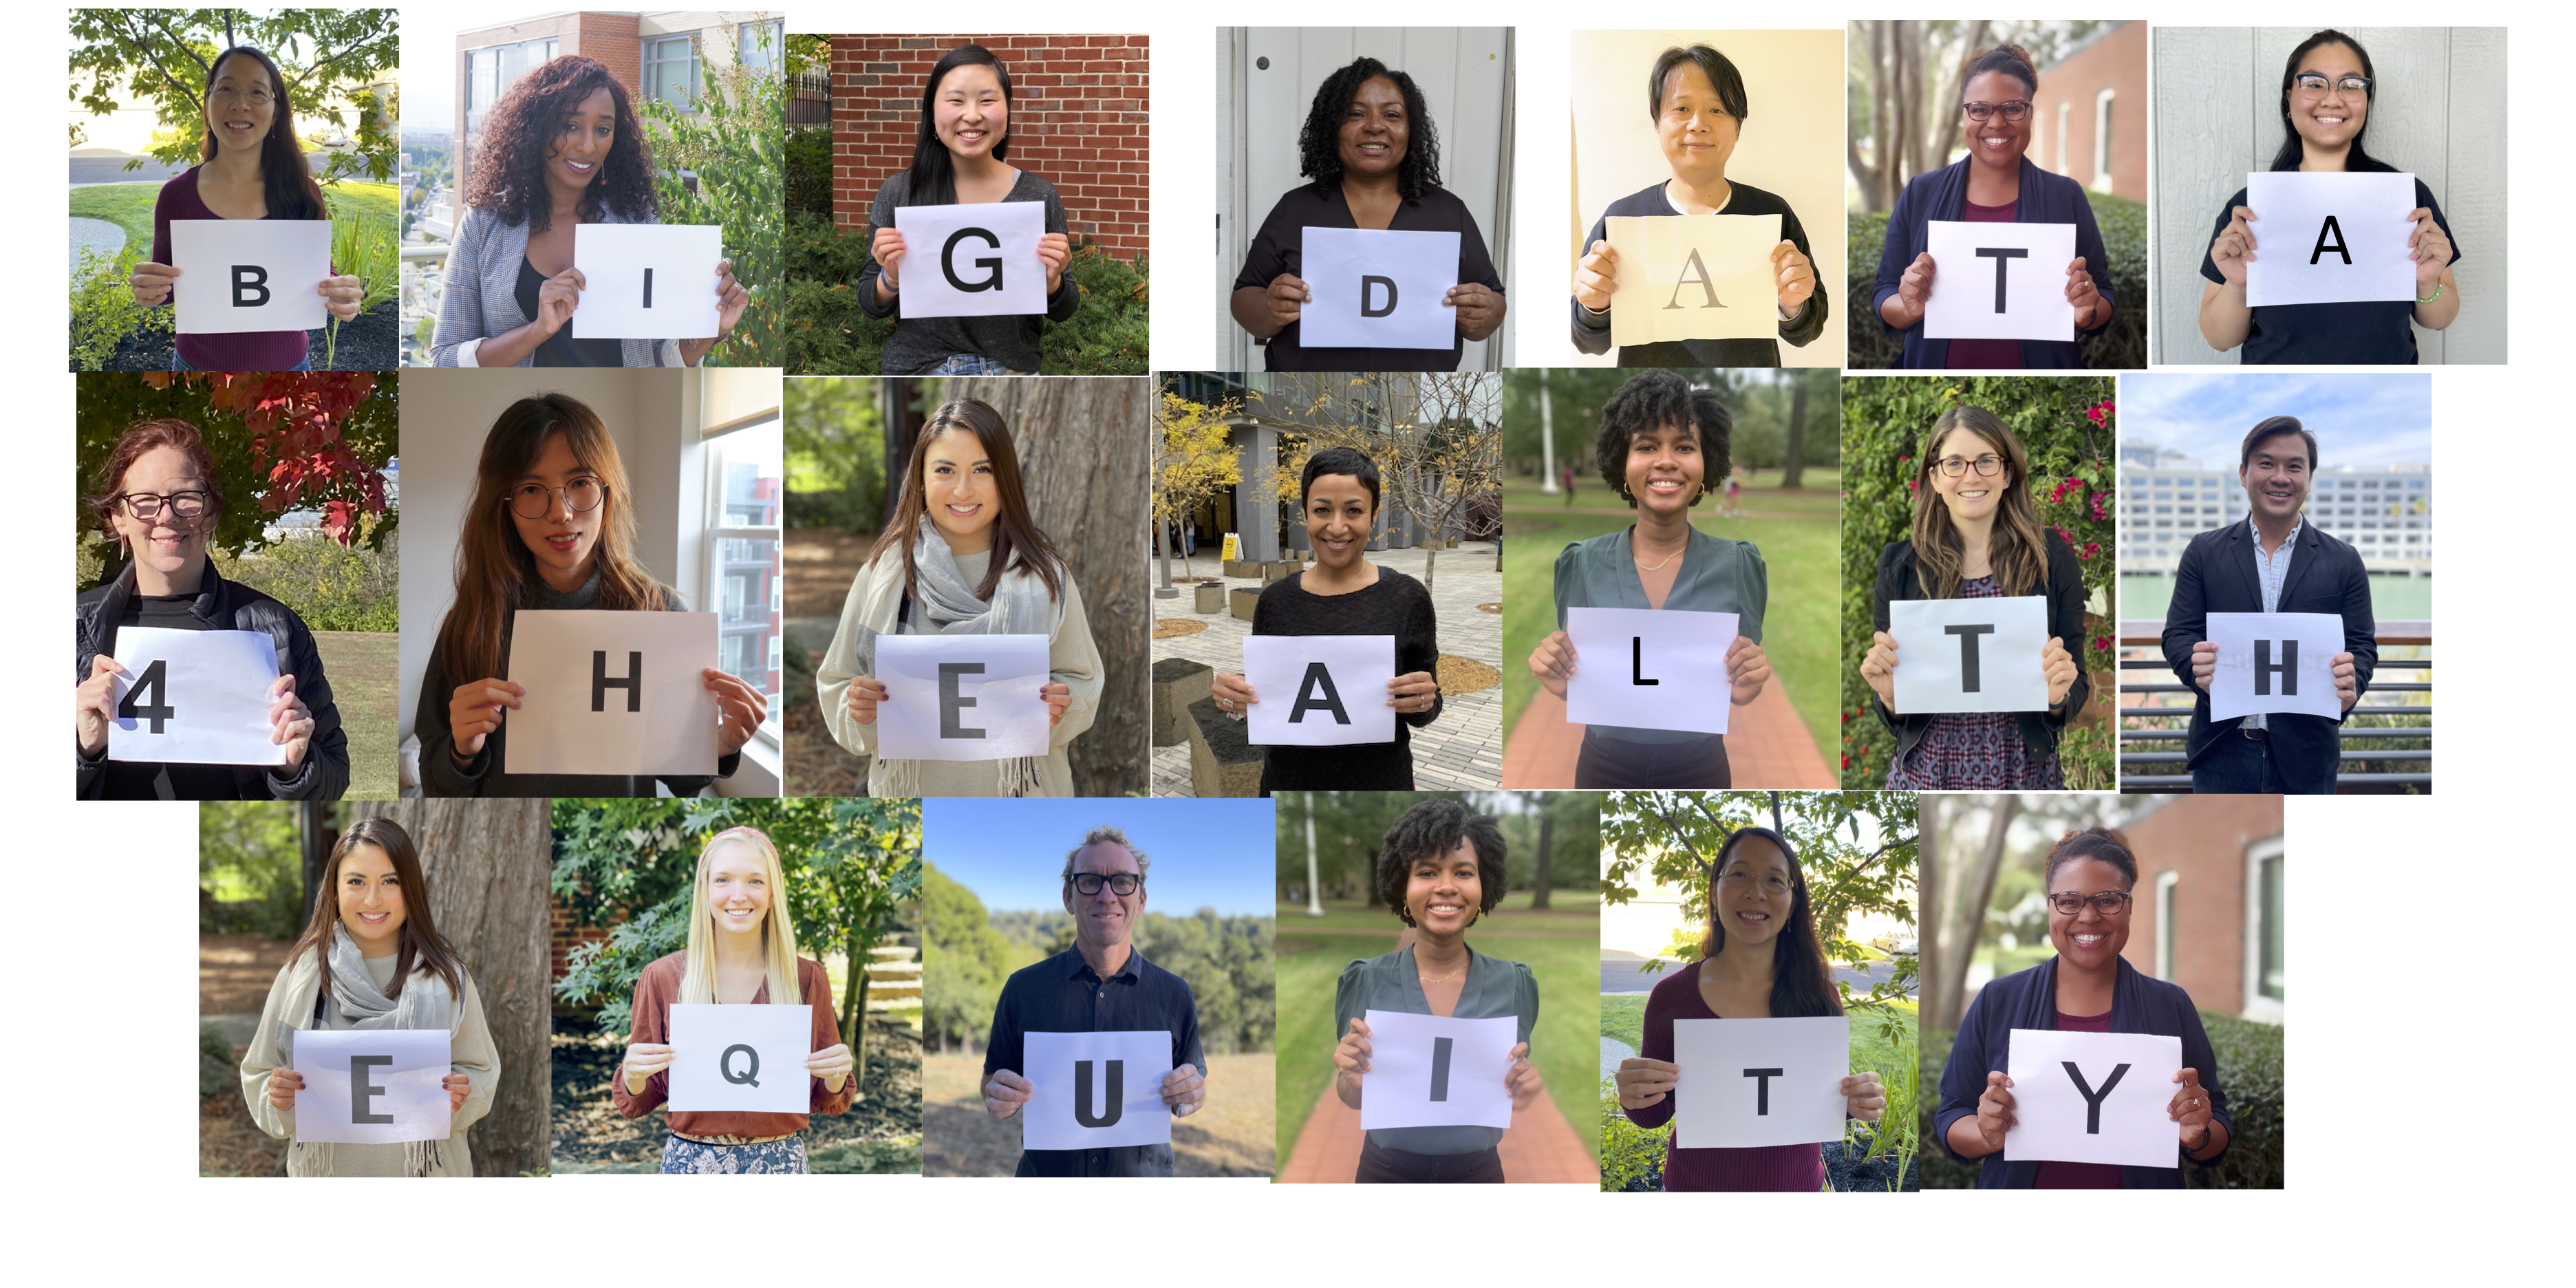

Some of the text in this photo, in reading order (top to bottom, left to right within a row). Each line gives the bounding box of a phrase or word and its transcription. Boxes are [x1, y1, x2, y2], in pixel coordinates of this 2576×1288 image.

[941, 227, 1003, 292] G
[2310, 216, 2352, 264] A
[232, 266, 270, 307] B
[643, 268, 653, 308] I
[1361, 275, 1397, 317] D
[1662, 248, 1728, 309] A
[1976, 248, 2028, 313] T
[592, 651, 641, 712] H
[1633, 637, 1659, 685] L
[1944, 624, 1994, 692] T
[2254, 640, 2298, 696] H
[118, 661, 174, 733] 4
[938, 663, 985, 738] E
[1288, 663, 1351, 724] A
[351, 1055, 394, 1124] E
[720, 1044, 760, 1088] Q
[1075, 1060, 1123, 1128] U
[1430, 1037, 1452, 1102] I
[1743, 1068, 1783, 1115] T
[2061, 1062, 2132, 1134] Y
